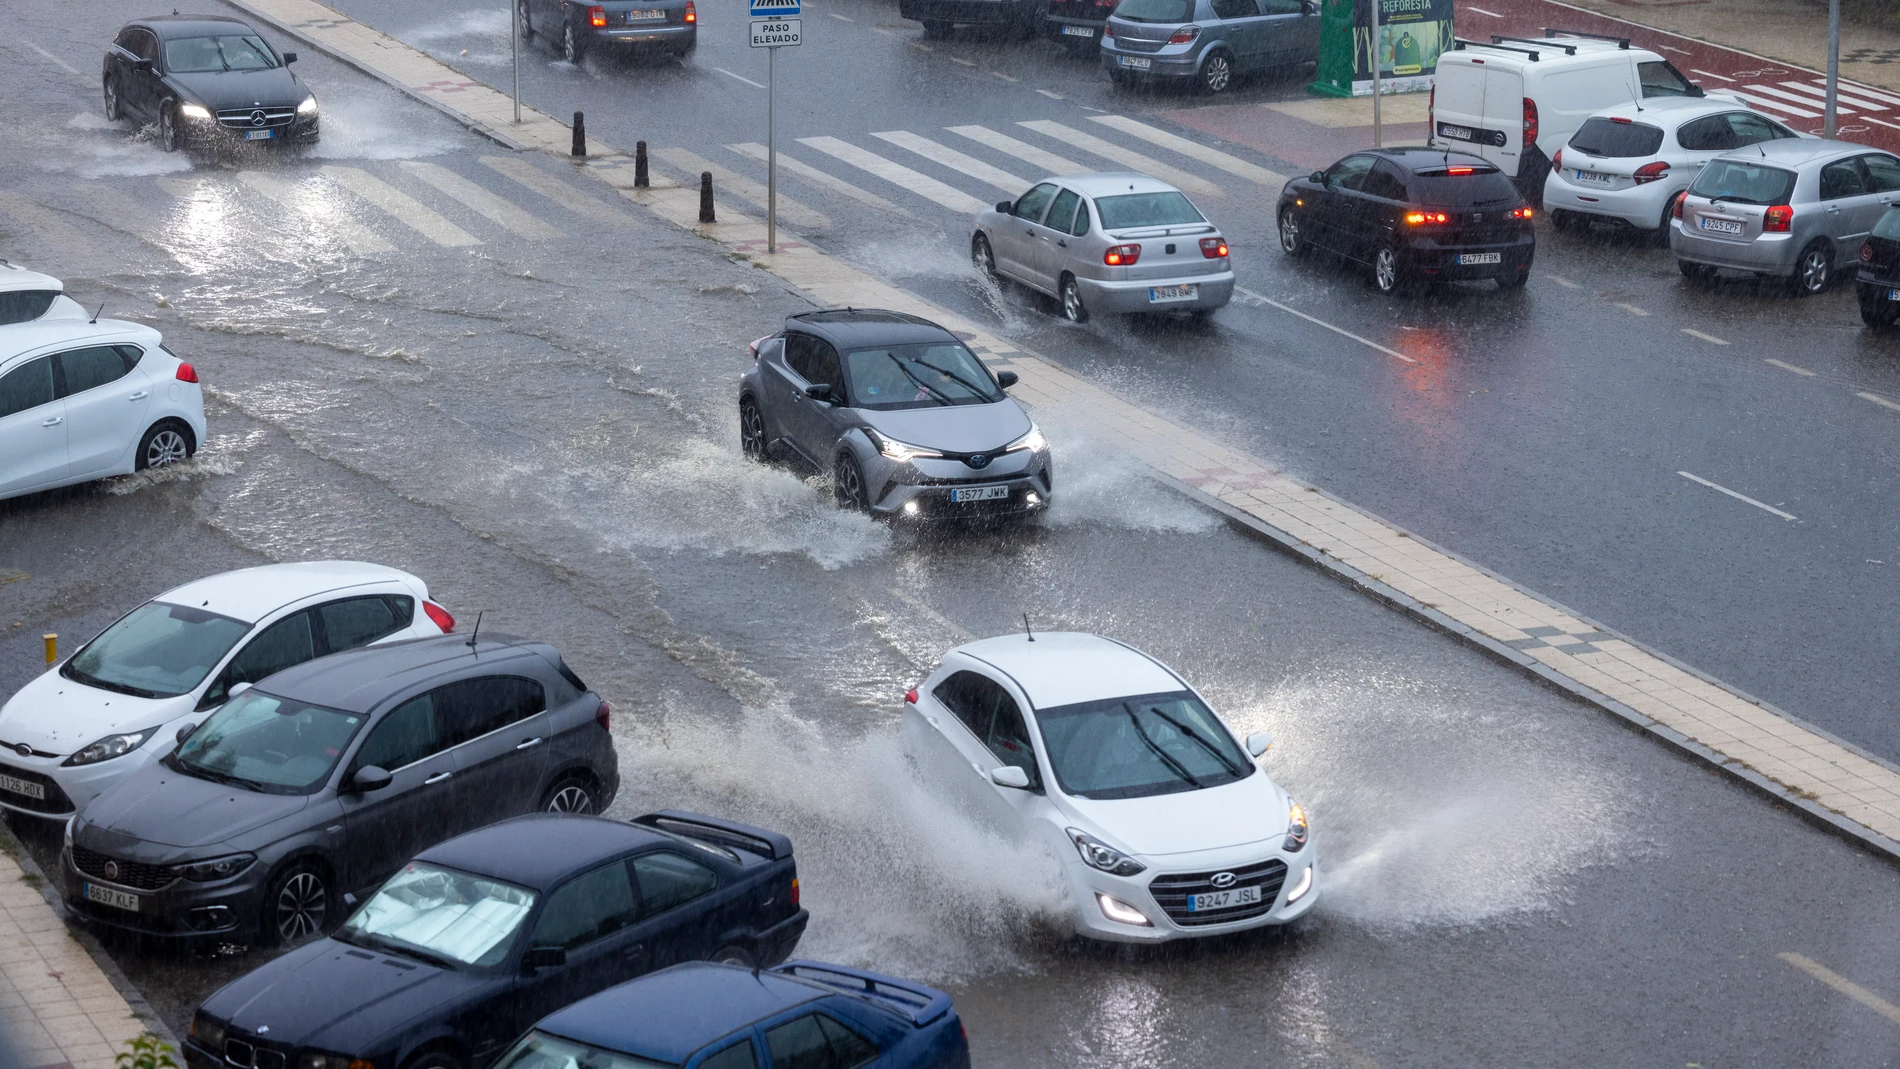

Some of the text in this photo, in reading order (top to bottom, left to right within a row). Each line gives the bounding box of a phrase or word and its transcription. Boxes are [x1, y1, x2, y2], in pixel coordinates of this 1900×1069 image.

[762, 24, 790, 33] PASO
[1066, 26, 1079, 35] 7825
[753, 34, 799, 44] ELEVADO
[1581, 171, 1597, 180] 9238
[1706, 220, 1739, 231] 9245 CPF
[1462, 253, 1498, 264] 6477 FBK
[1156, 288, 1177, 299] 2849
[959, 487, 1006, 500] 3577 JWK
[0, 775, 41, 797] 1126 HDX
[90, 885, 135, 909] 6637 KLF
[1197, 889, 1258, 909] 9247 JSL
